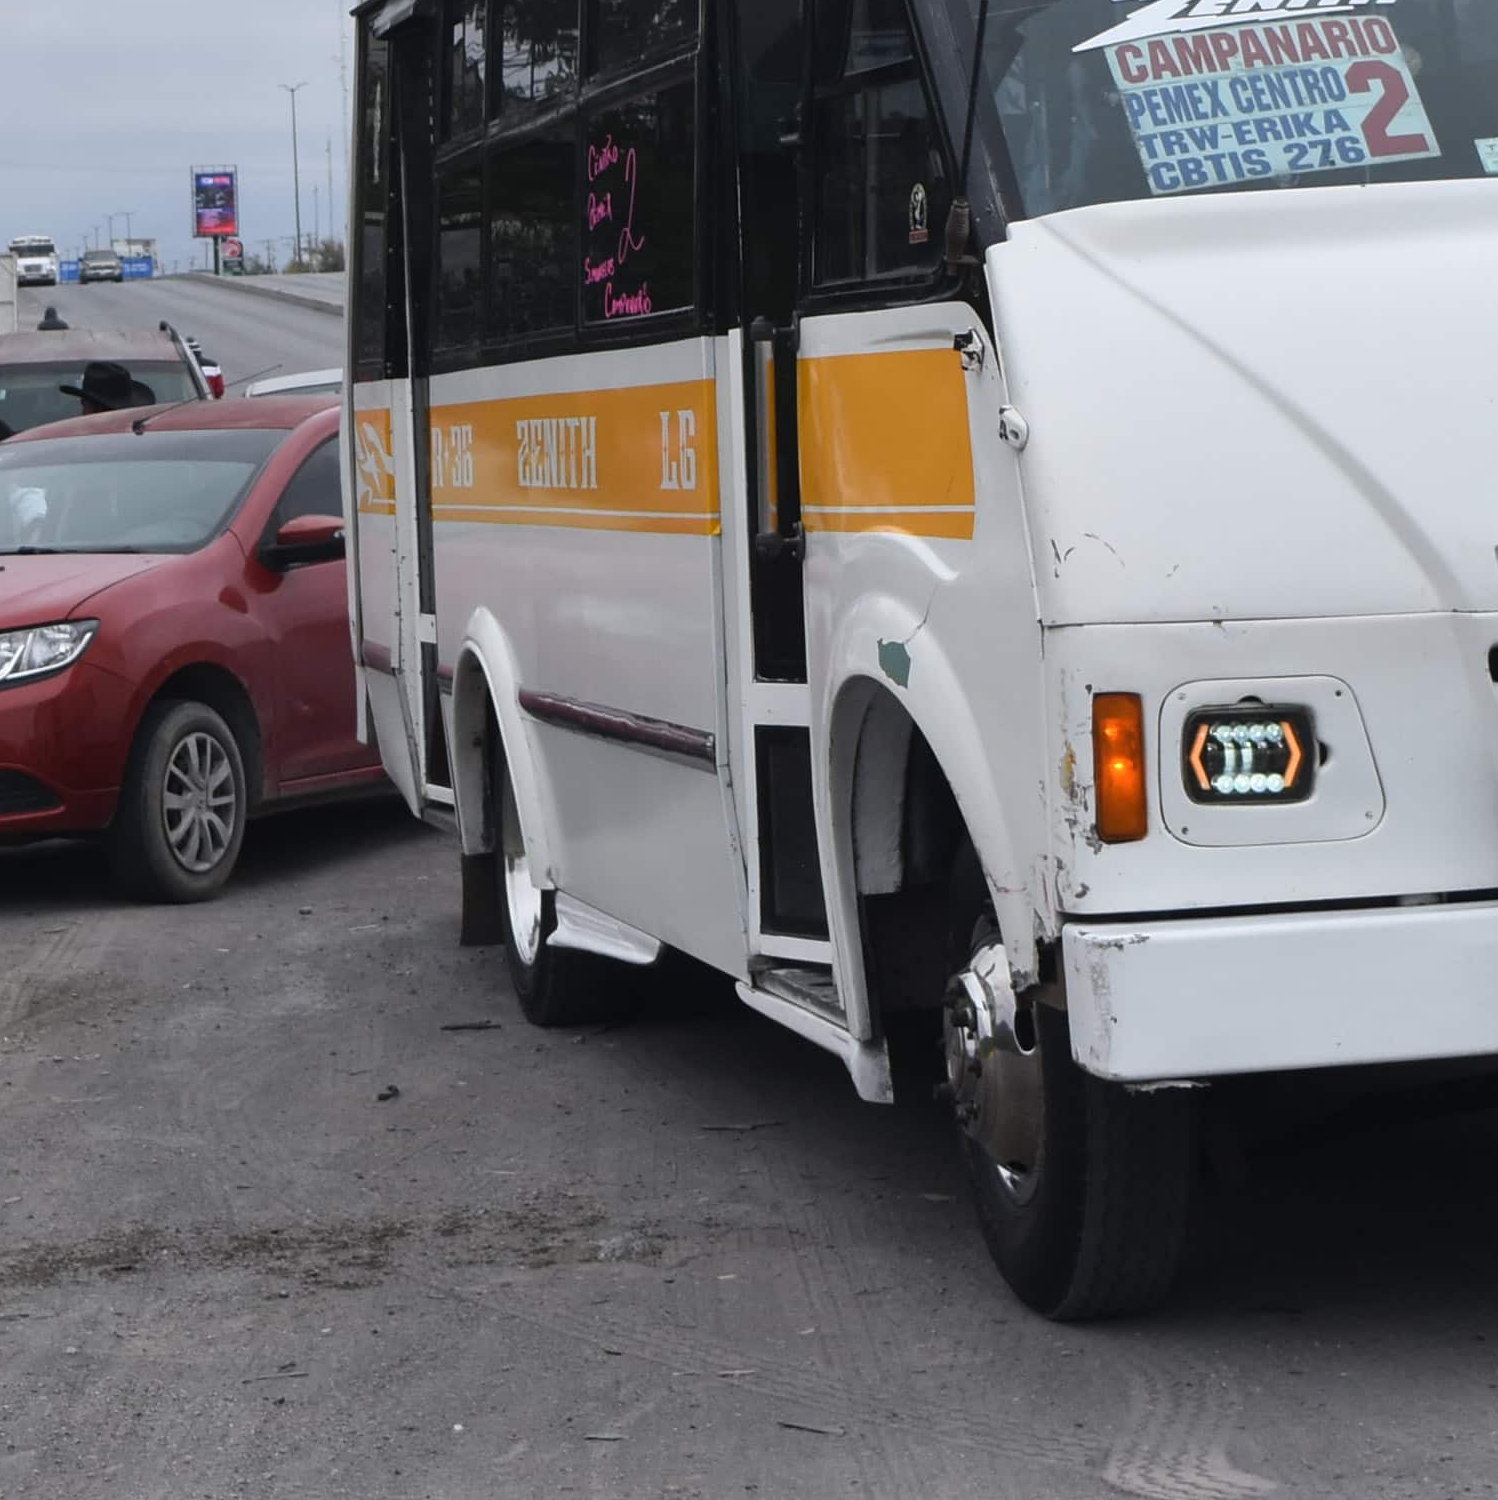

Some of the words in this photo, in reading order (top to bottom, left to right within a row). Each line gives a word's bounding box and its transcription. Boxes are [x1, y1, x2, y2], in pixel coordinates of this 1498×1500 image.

[1114, 17, 1399, 85] CAMPANARIO
[1123, 78, 1230, 130] PEMEX
[1229, 66, 1347, 113] CENTRO
[1344, 59, 1430, 159] 2
[1139, 108, 1351, 160] TRW-ERIKA
[1150, 145, 1273, 192] CBTIS
[1282, 135, 1367, 173] 276
[516, 416, 598, 489] ZENITH
